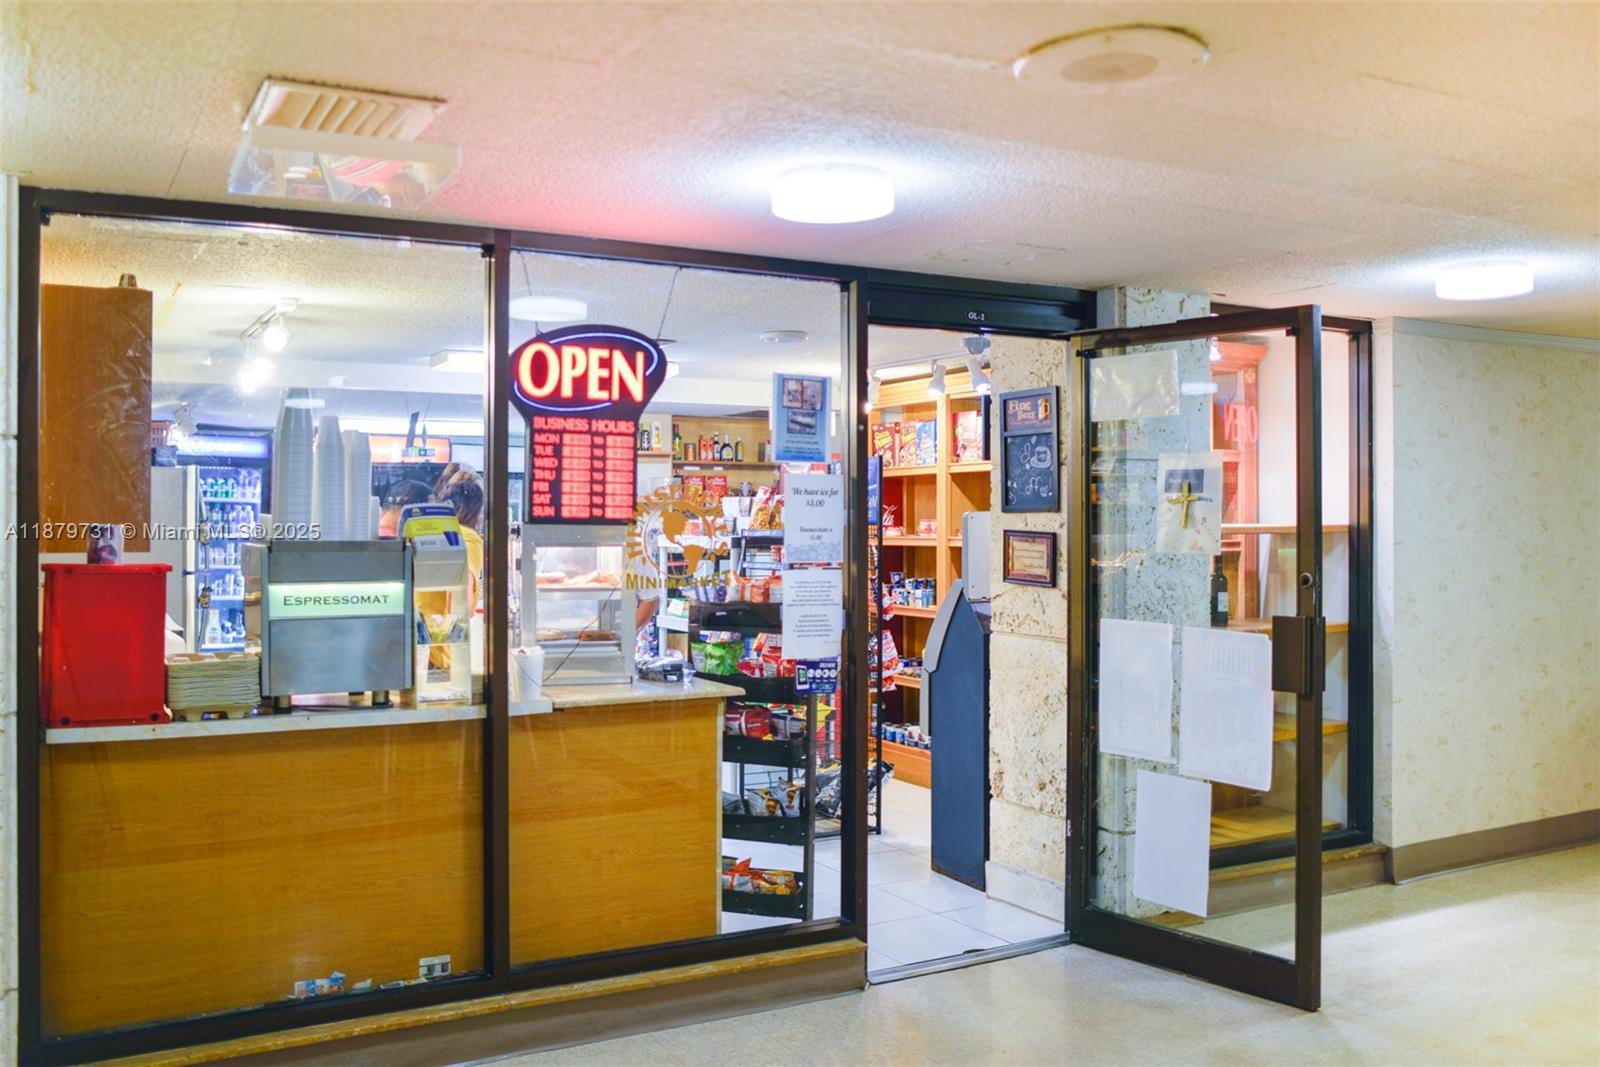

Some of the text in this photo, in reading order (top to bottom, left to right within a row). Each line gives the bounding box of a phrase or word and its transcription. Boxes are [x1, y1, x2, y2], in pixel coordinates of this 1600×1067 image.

[518, 342, 645, 402] OPEN
[533, 416, 635, 434] BUSINESS HOURS
[533, 432, 560, 444] MON
[533, 445, 554, 456] TUE
[533, 457, 558, 468] WED
[533, 469, 556, 480] THU
[532, 481, 549, 492] FRI
[532, 493, 552, 504] SAT
[804, 488, 819, 496] have
[829, 488, 839, 498] for
[532, 505, 555, 517] SUN
[283, 595, 390, 606] ESPRESSOMAT
